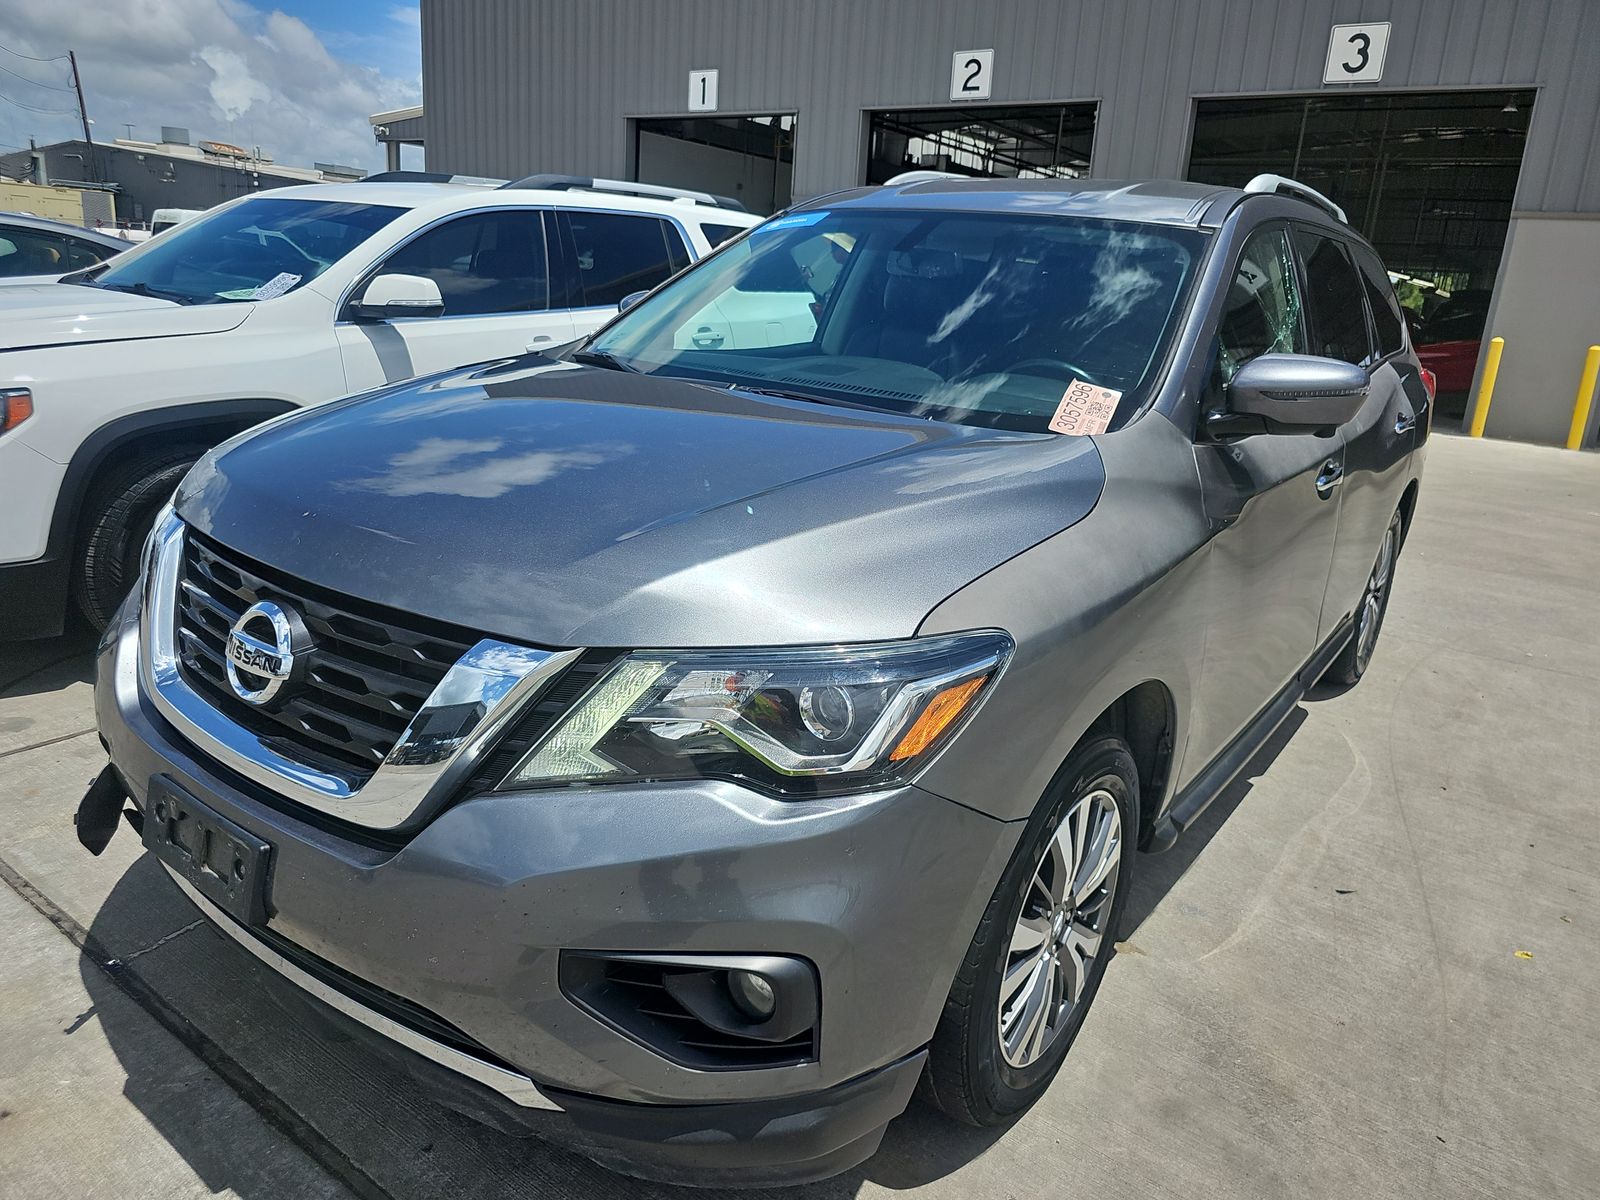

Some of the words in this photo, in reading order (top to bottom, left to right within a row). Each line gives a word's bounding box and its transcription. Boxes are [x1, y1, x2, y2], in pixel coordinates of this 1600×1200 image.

[1342, 32, 1371, 74] 3
[700, 76, 707, 105] 1
[961, 58, 982, 92] 2
[1056, 383, 1093, 431] 3057596
[228, 635, 279, 673] NISSAN
